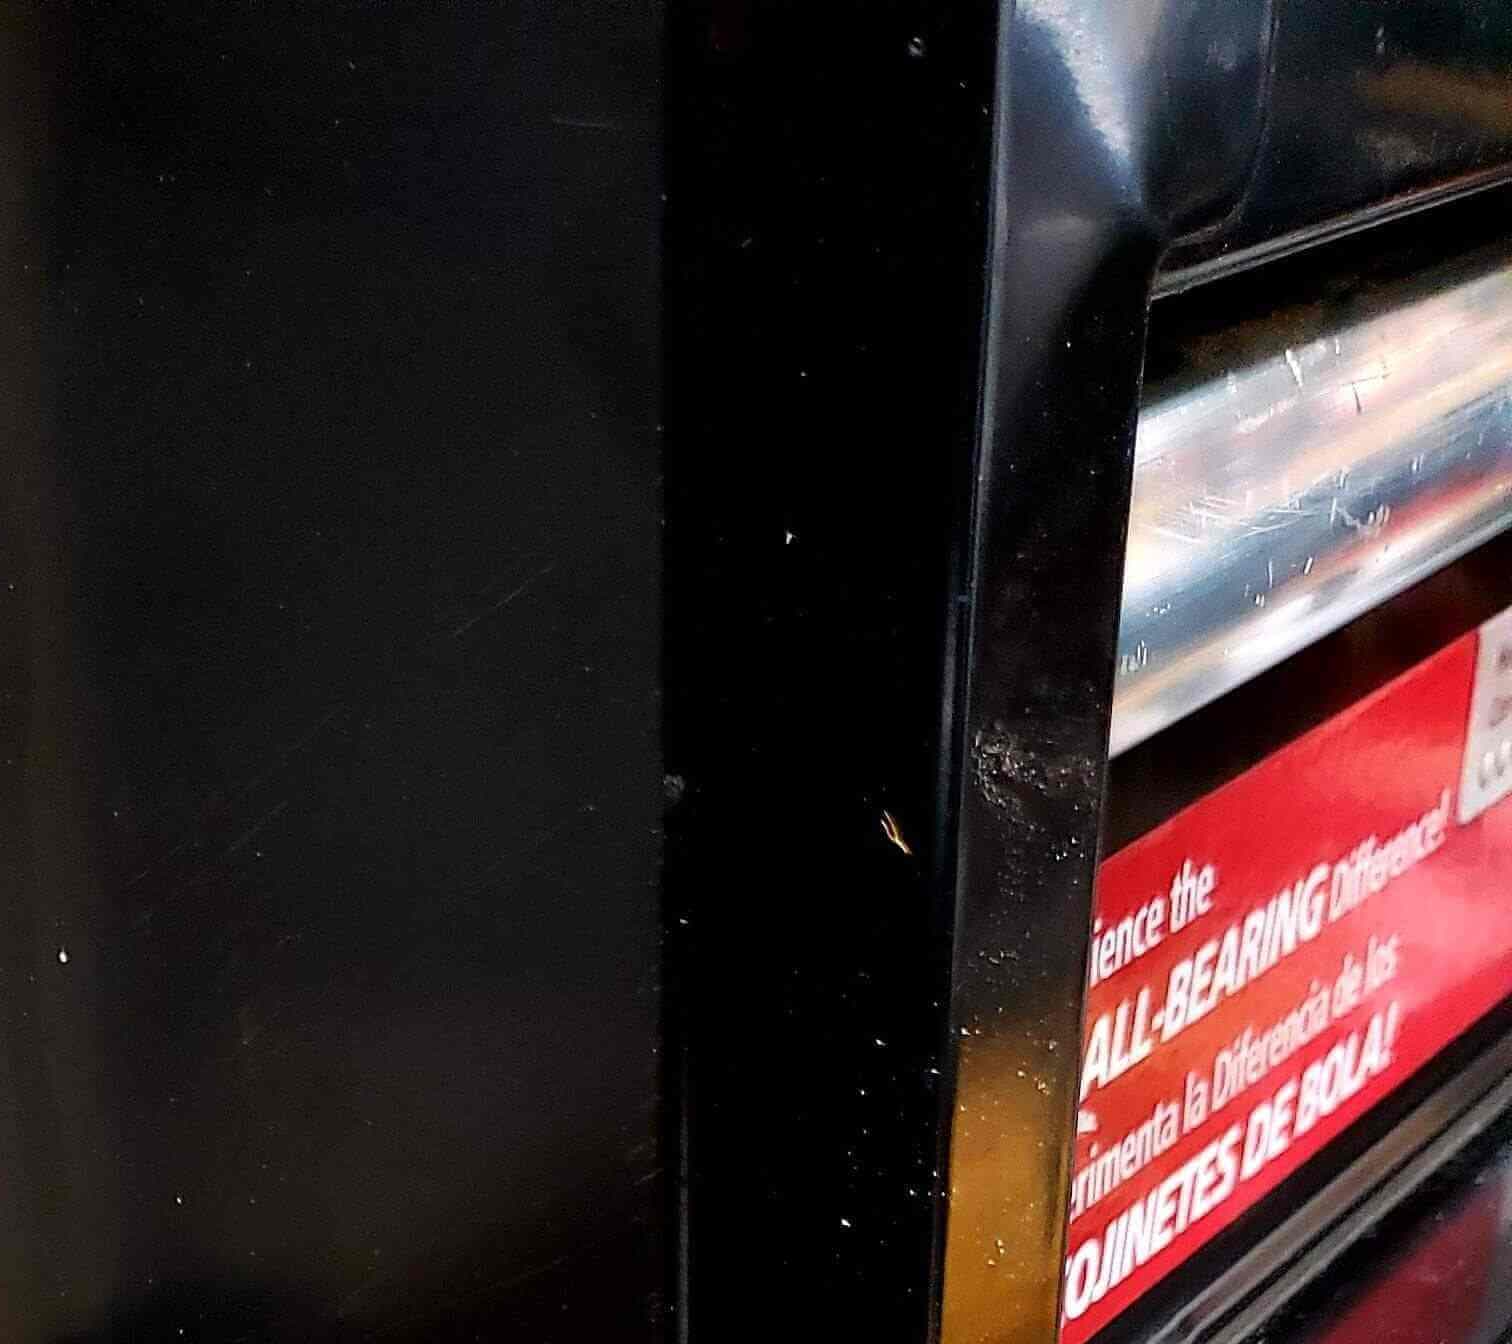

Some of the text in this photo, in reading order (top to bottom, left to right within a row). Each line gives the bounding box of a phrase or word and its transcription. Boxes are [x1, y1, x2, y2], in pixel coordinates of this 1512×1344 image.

[1078, 786, 1452, 1104] ALL-BEARING Difference!
[1089, 857, 1217, 988] ience the
[1182, 1071, 1209, 1134] la
[1211, 978, 1334, 1113] Diferencia
[1333, 951, 1364, 1020] de
[1364, 934, 1400, 996] los
[1239, 1075, 1298, 1182] DE
[1292, 1000, 1400, 1139] BOLA!
